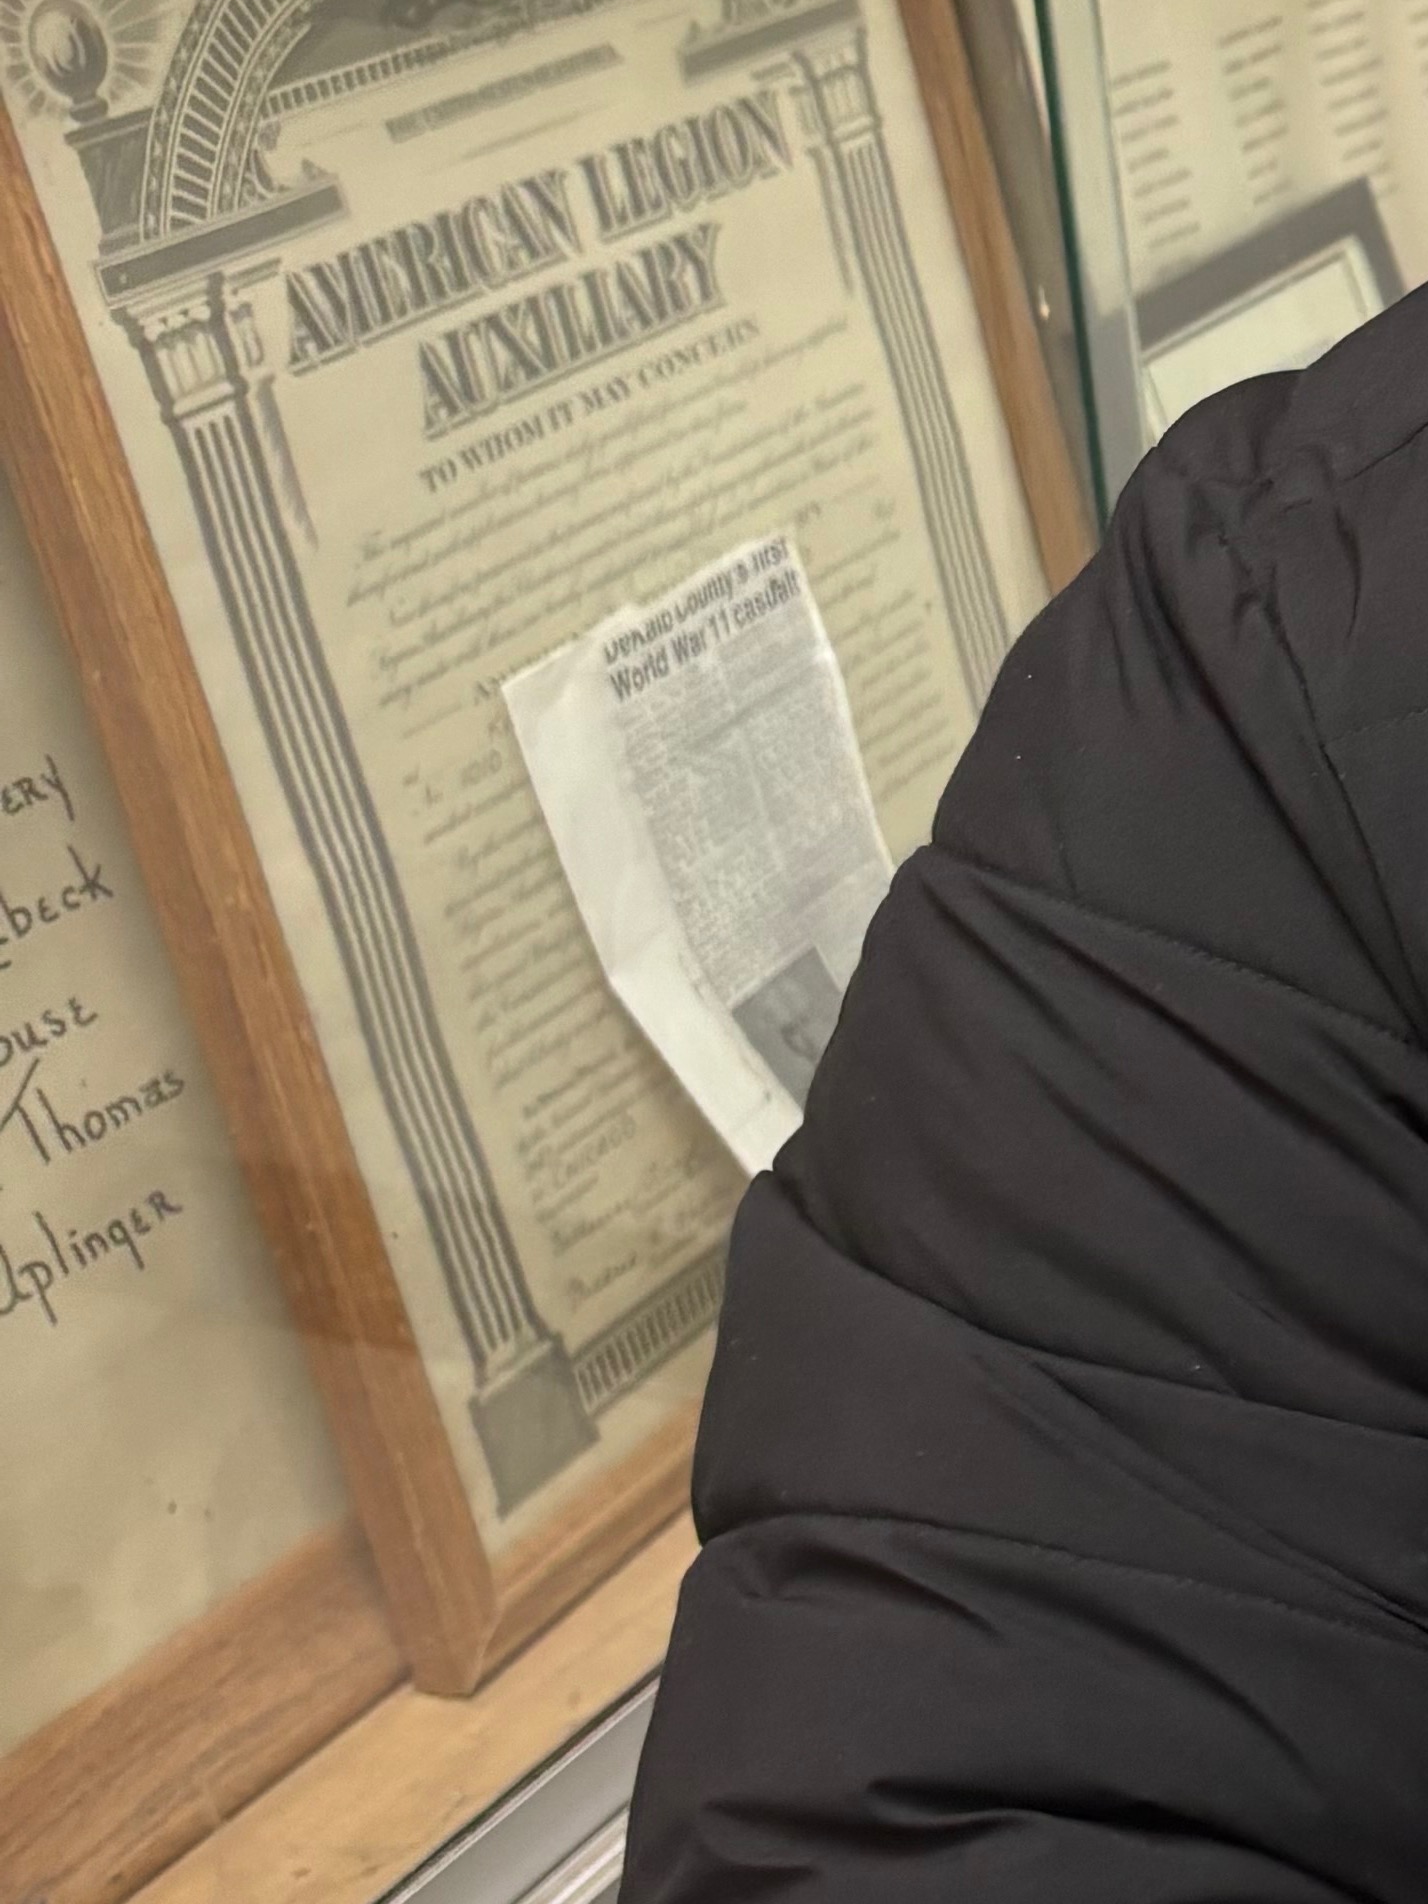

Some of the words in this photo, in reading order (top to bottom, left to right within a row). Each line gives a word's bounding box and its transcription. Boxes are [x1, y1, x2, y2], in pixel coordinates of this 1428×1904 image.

[287, 168, 581, 375] AMERICAN
[583, 90, 793, 242] LEGION
[418, 222, 722, 439] AUXILIARY
[420, 458, 458, 493] TO
[458, 416, 546, 471] WHOM
[547, 402, 575, 434] IT
[578, 376, 631, 416] MAY
[635, 319, 760, 389] CONCERN
[610, 648, 670, 701] World
[670, 629, 708, 666] War
[709, 608, 732, 644] 11
[731, 570, 801, 628] casualt
[0, 753, 74, 821] ERY
